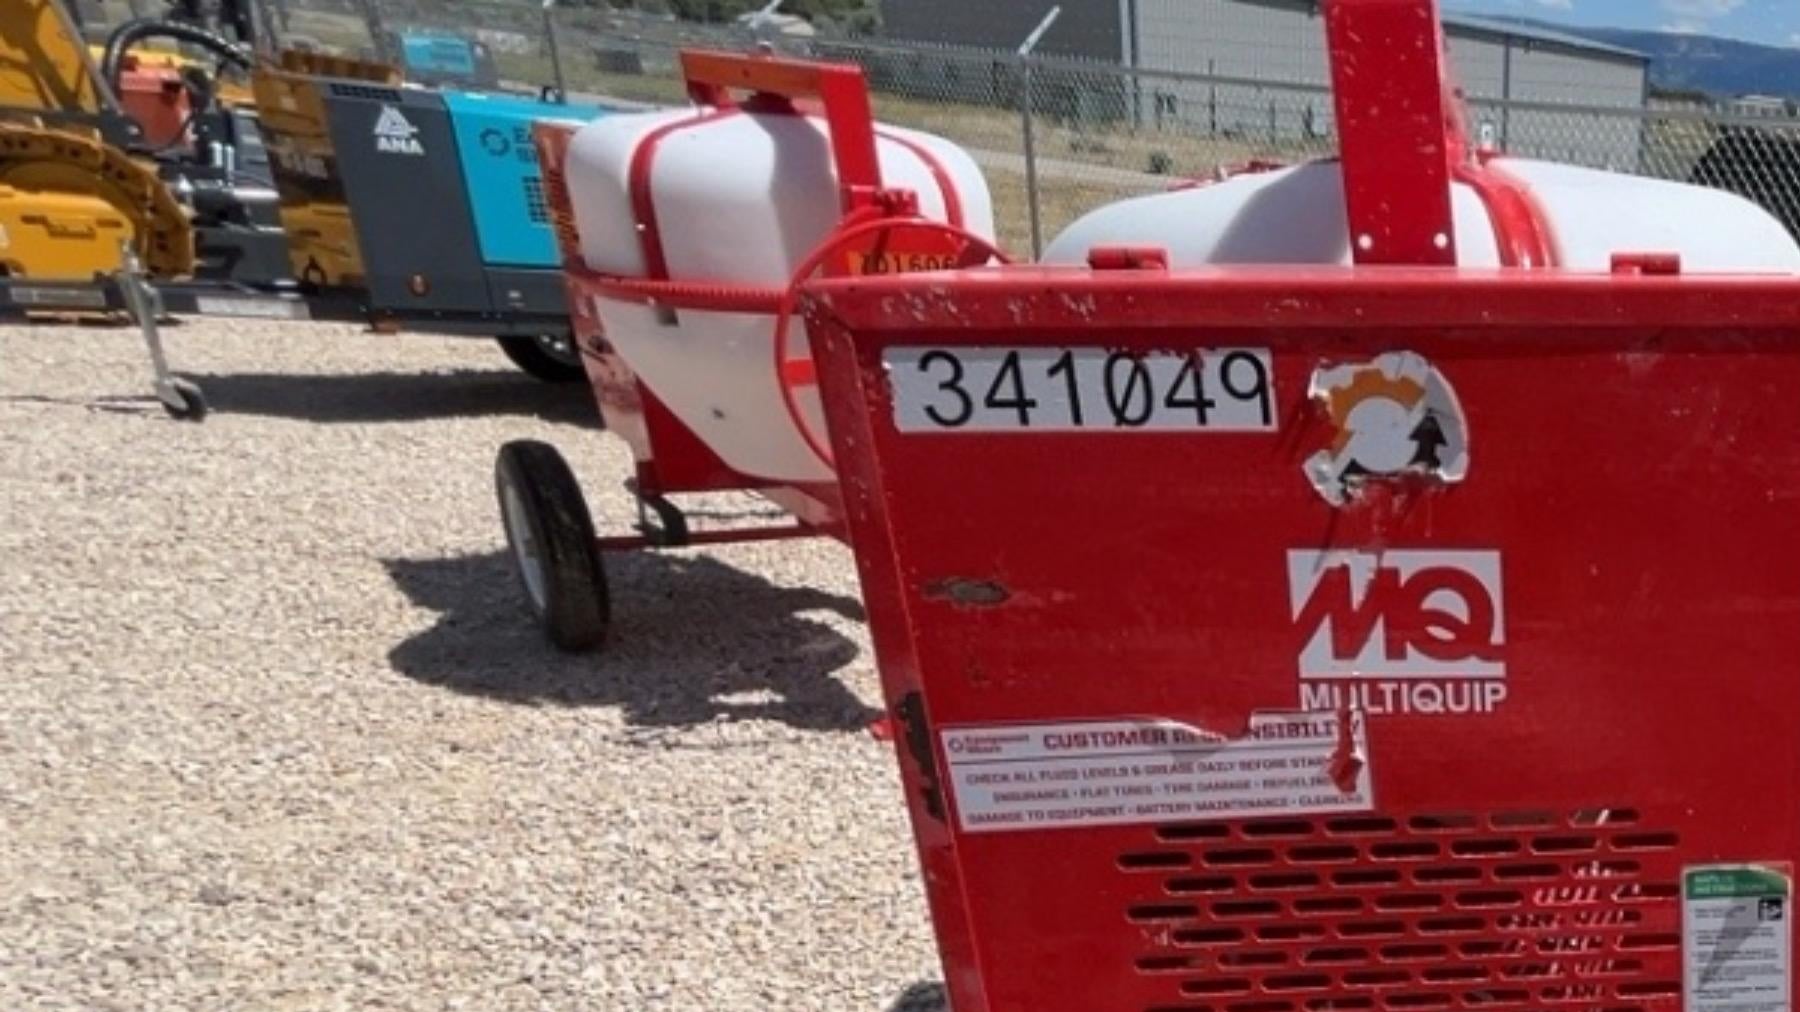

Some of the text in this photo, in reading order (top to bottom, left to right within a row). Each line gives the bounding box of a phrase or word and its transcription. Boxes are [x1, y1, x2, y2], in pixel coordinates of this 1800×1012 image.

[377, 136, 425, 156] ANA
[917, 350, 1273, 427] 341049
[1290, 562, 1506, 664] MQ
[1301, 682, 1508, 714] MULTIQUIP
[1043, 727, 1168, 751] CUSTOMER
[966, 772, 1009, 785] CHECK
[1013, 770, 1038, 783] ALL
[1082, 766, 1130, 780] LEVELS
[1144, 762, 1195, 777] GREASE
[1198, 760, 1233, 774] DAILY
[1238, 758, 1288, 772] BEFORE
[1080, 788, 1111, 800] FLAT
[1197, 779, 1251, 793] DAMAGE
[968, 812, 1024, 825] DAMAGE
[1026, 810, 1045, 822] TO
[1047, 807, 1125, 821] EQUIPMENT
[1135, 802, 1192, 816] BATTERY
[1195, 798, 1290, 812] MAINTENANCE
